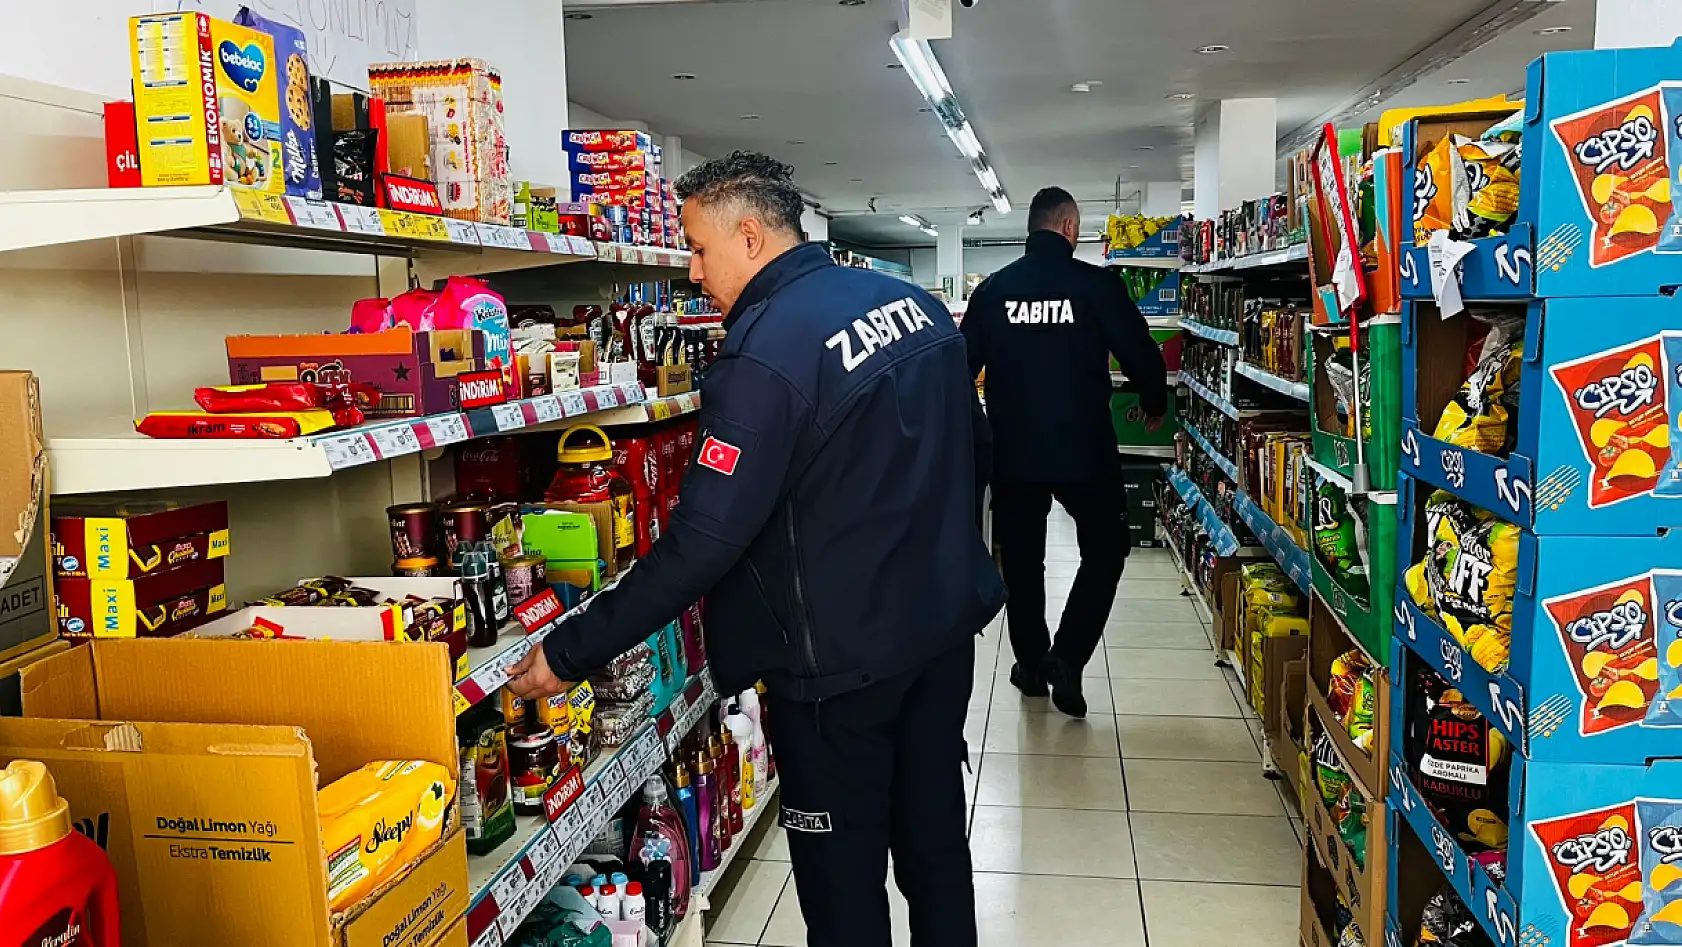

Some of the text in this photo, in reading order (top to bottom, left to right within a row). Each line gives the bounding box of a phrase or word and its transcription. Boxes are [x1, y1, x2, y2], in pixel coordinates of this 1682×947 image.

[221, 48, 262, 72] bebelac
[1005, 299, 1074, 324] ZABITA
[825, 297, 934, 372] ZABITA
[96, 527, 111, 570] Maxi
[104, 588, 119, 631] Maxi
[1432, 719, 1480, 741] HIPS
[1423, 779, 1482, 799] KABUKLU
[156, 816, 278, 837] Doğal Limon Yağı
[365, 810, 413, 853] Sleepy
[784, 811, 824, 829] ZABITA
[169, 844, 272, 862] Ekstra Temizlik
